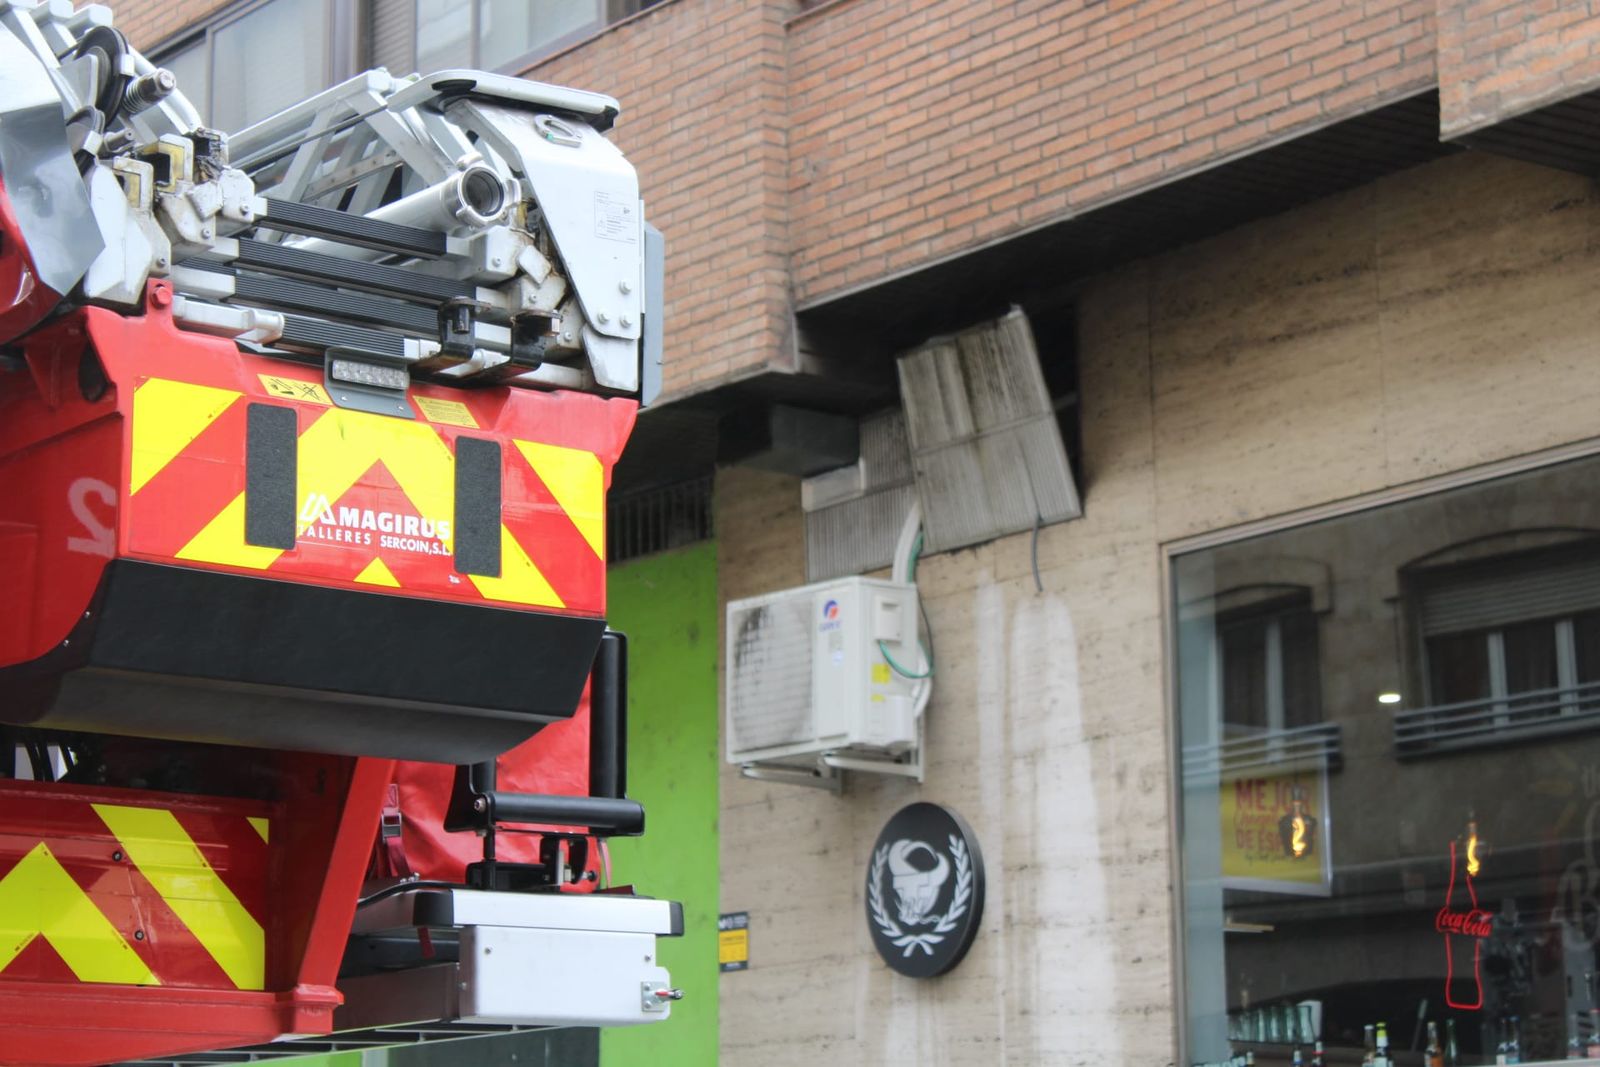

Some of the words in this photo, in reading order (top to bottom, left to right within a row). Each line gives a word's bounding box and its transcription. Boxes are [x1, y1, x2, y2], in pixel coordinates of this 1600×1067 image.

[298, 525, 371, 545] TALLERES
[339, 506, 451, 540] MAGIRUS
[1235, 779, 1312, 815] MEJOR
